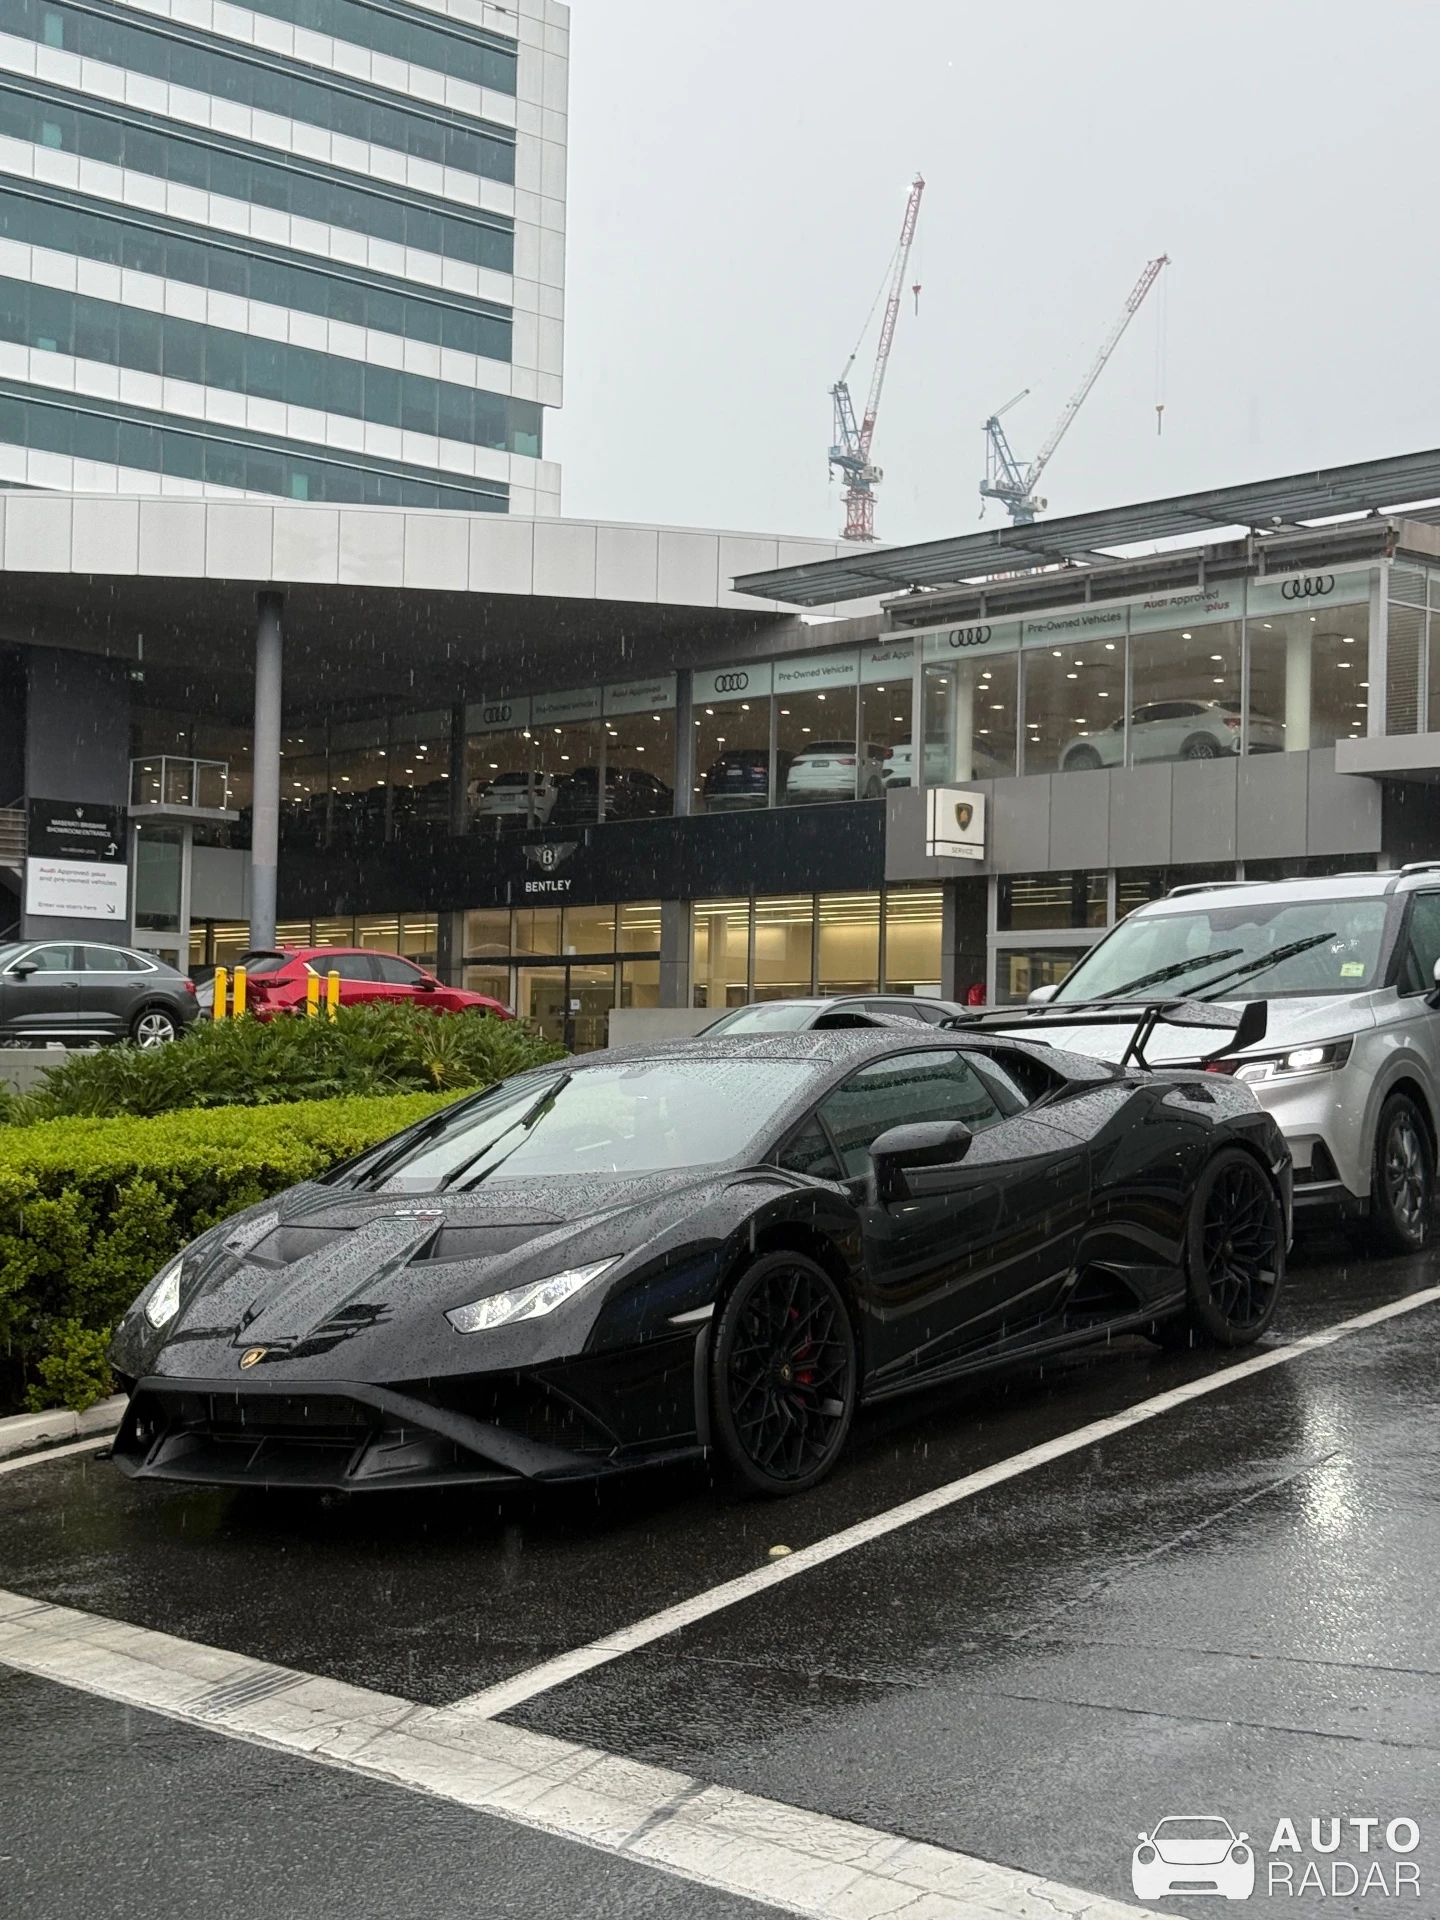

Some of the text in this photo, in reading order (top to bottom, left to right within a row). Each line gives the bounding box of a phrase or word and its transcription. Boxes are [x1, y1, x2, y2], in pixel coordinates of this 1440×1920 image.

[1143, 589, 1219, 609] Audi Approved
[1027, 612, 1122, 633] Pre-Owned Vehicles
[871, 651, 891, 663] Audi
[778, 664, 854, 681] Pre-Owned Vehicles
[628, 685, 661, 697] Approved
[951, 847, 974, 856] SERVICE
[57, 868, 89, 876] Approved
[525, 880, 572, 893] BENTLEY
